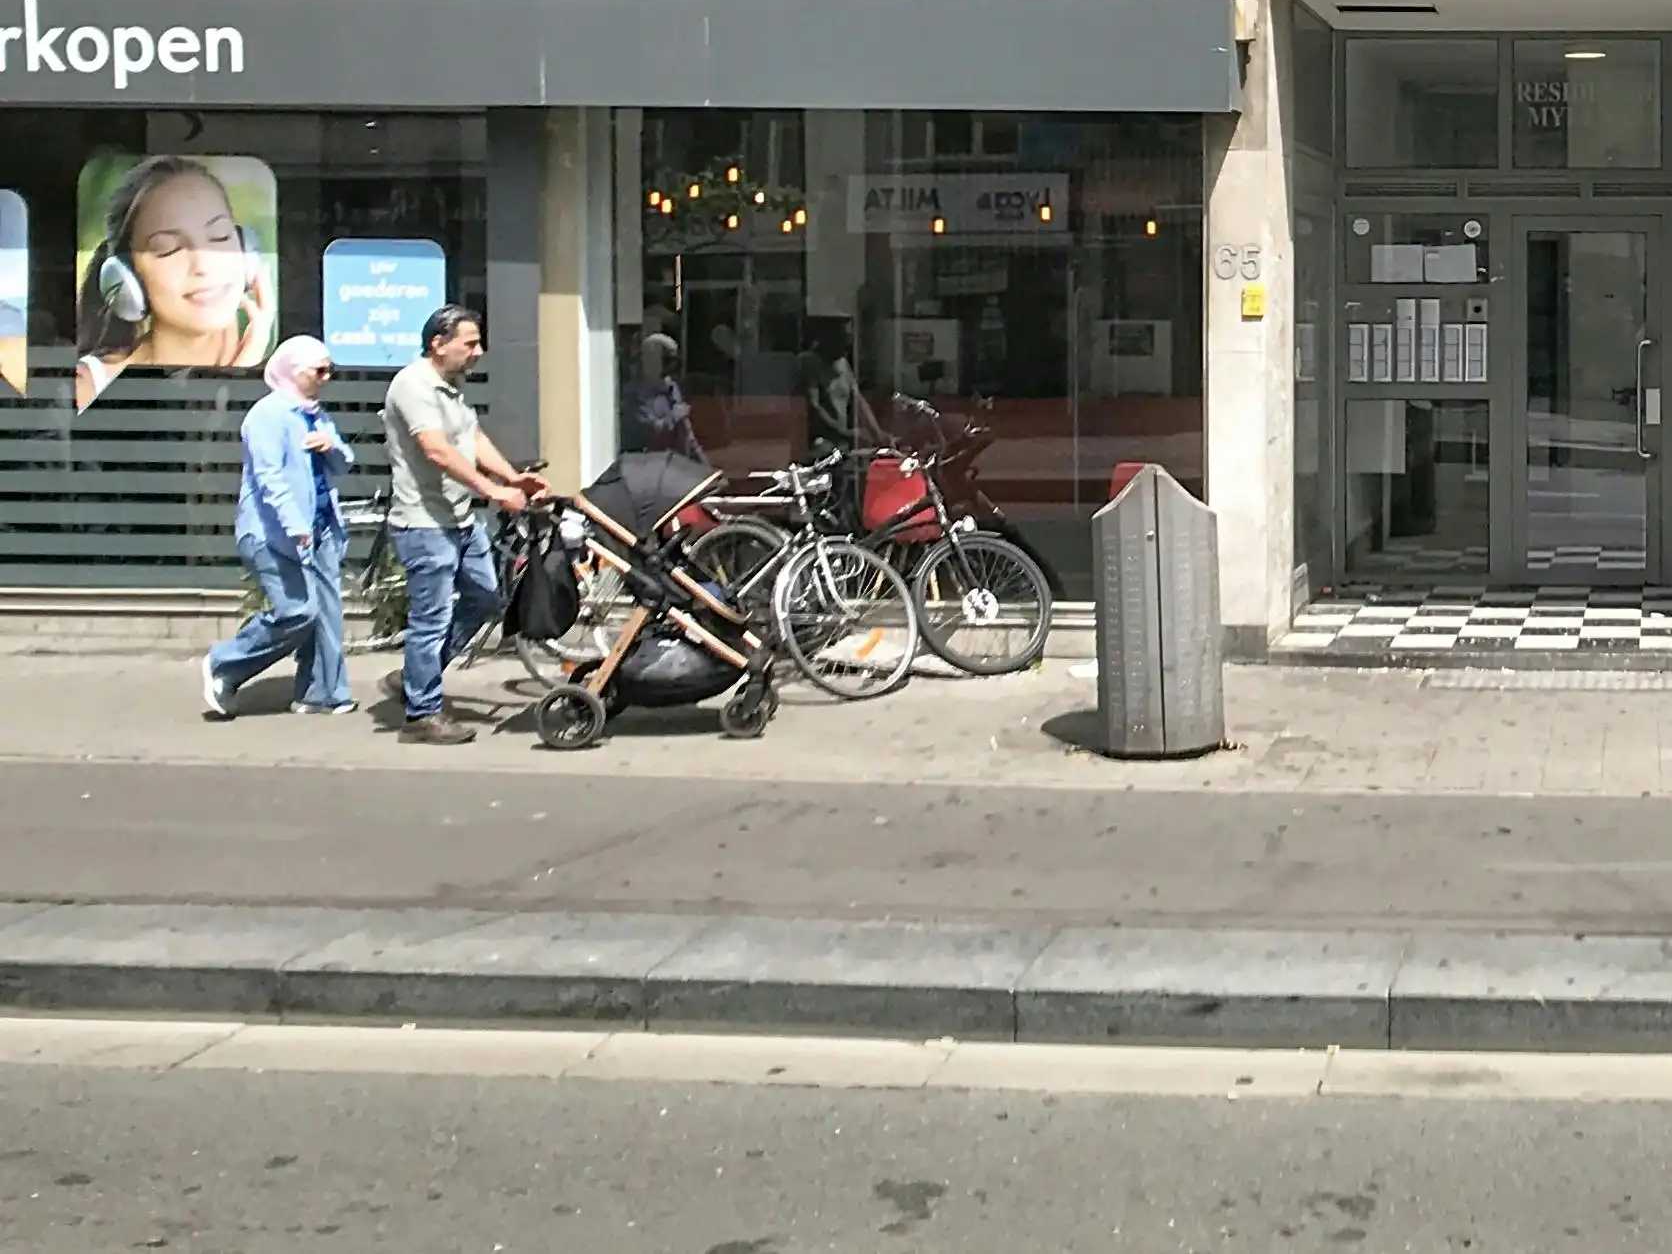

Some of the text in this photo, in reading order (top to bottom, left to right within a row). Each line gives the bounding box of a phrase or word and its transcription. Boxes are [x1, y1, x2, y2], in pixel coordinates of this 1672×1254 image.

[1213, 244, 1262, 281] 65
[339, 278, 429, 303] goederen
[330, 325, 377, 345] cash
